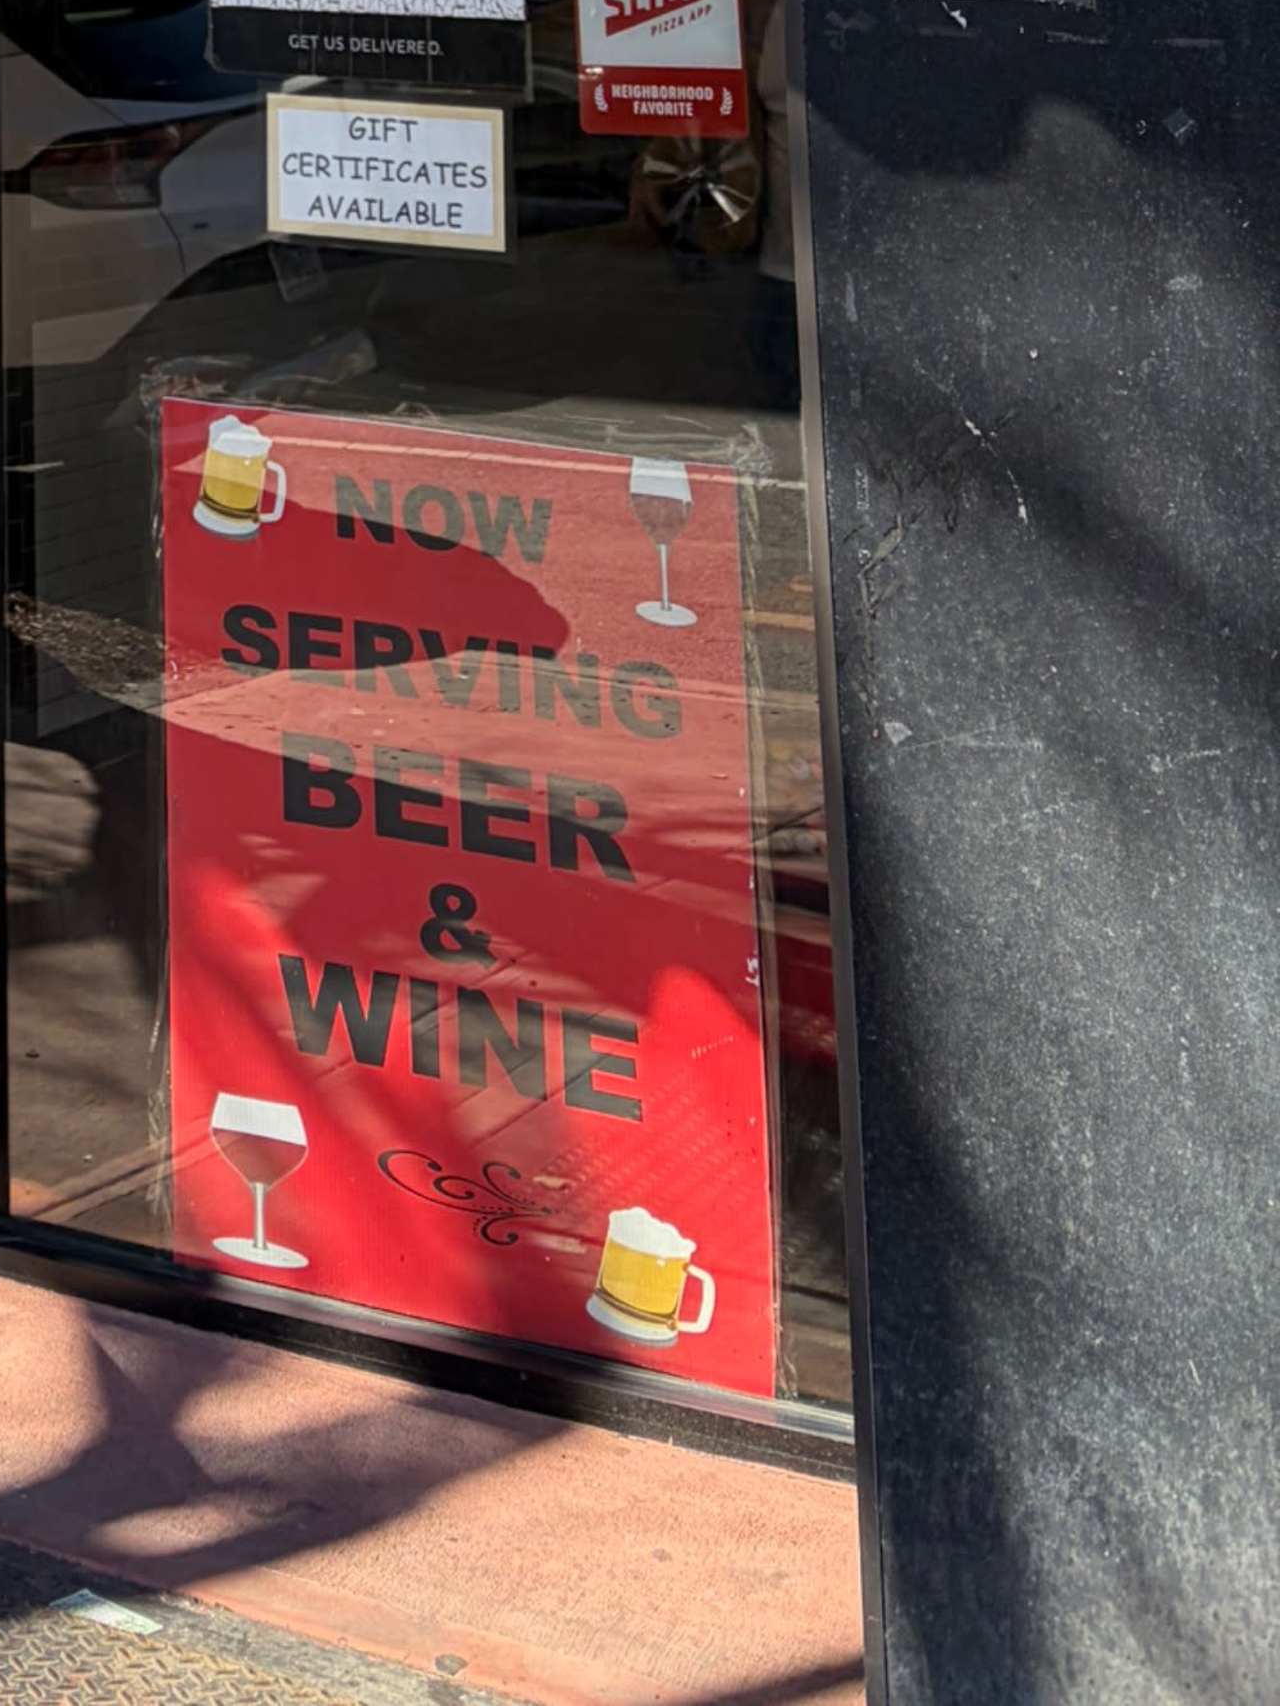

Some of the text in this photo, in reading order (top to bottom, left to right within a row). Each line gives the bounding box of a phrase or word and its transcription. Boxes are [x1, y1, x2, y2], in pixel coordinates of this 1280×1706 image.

[649, 3, 713, 37] PIZZA APP
[287, 34, 444, 56] GET US DELIVERED.
[611, 84, 714, 101] NEIGHBORHOOD
[633, 101, 694, 117] FAVORITE
[348, 115, 419, 144] GIFT
[281, 152, 489, 190] CERTIFICATES
[307, 195, 464, 229] AVAILABLE
[335, 473, 553, 566] NOW
[220, 601, 685, 741] SERVING
[280, 730, 637, 885] BEER
[419, 881, 496, 974] &
[276, 951, 643, 1123] WINE
